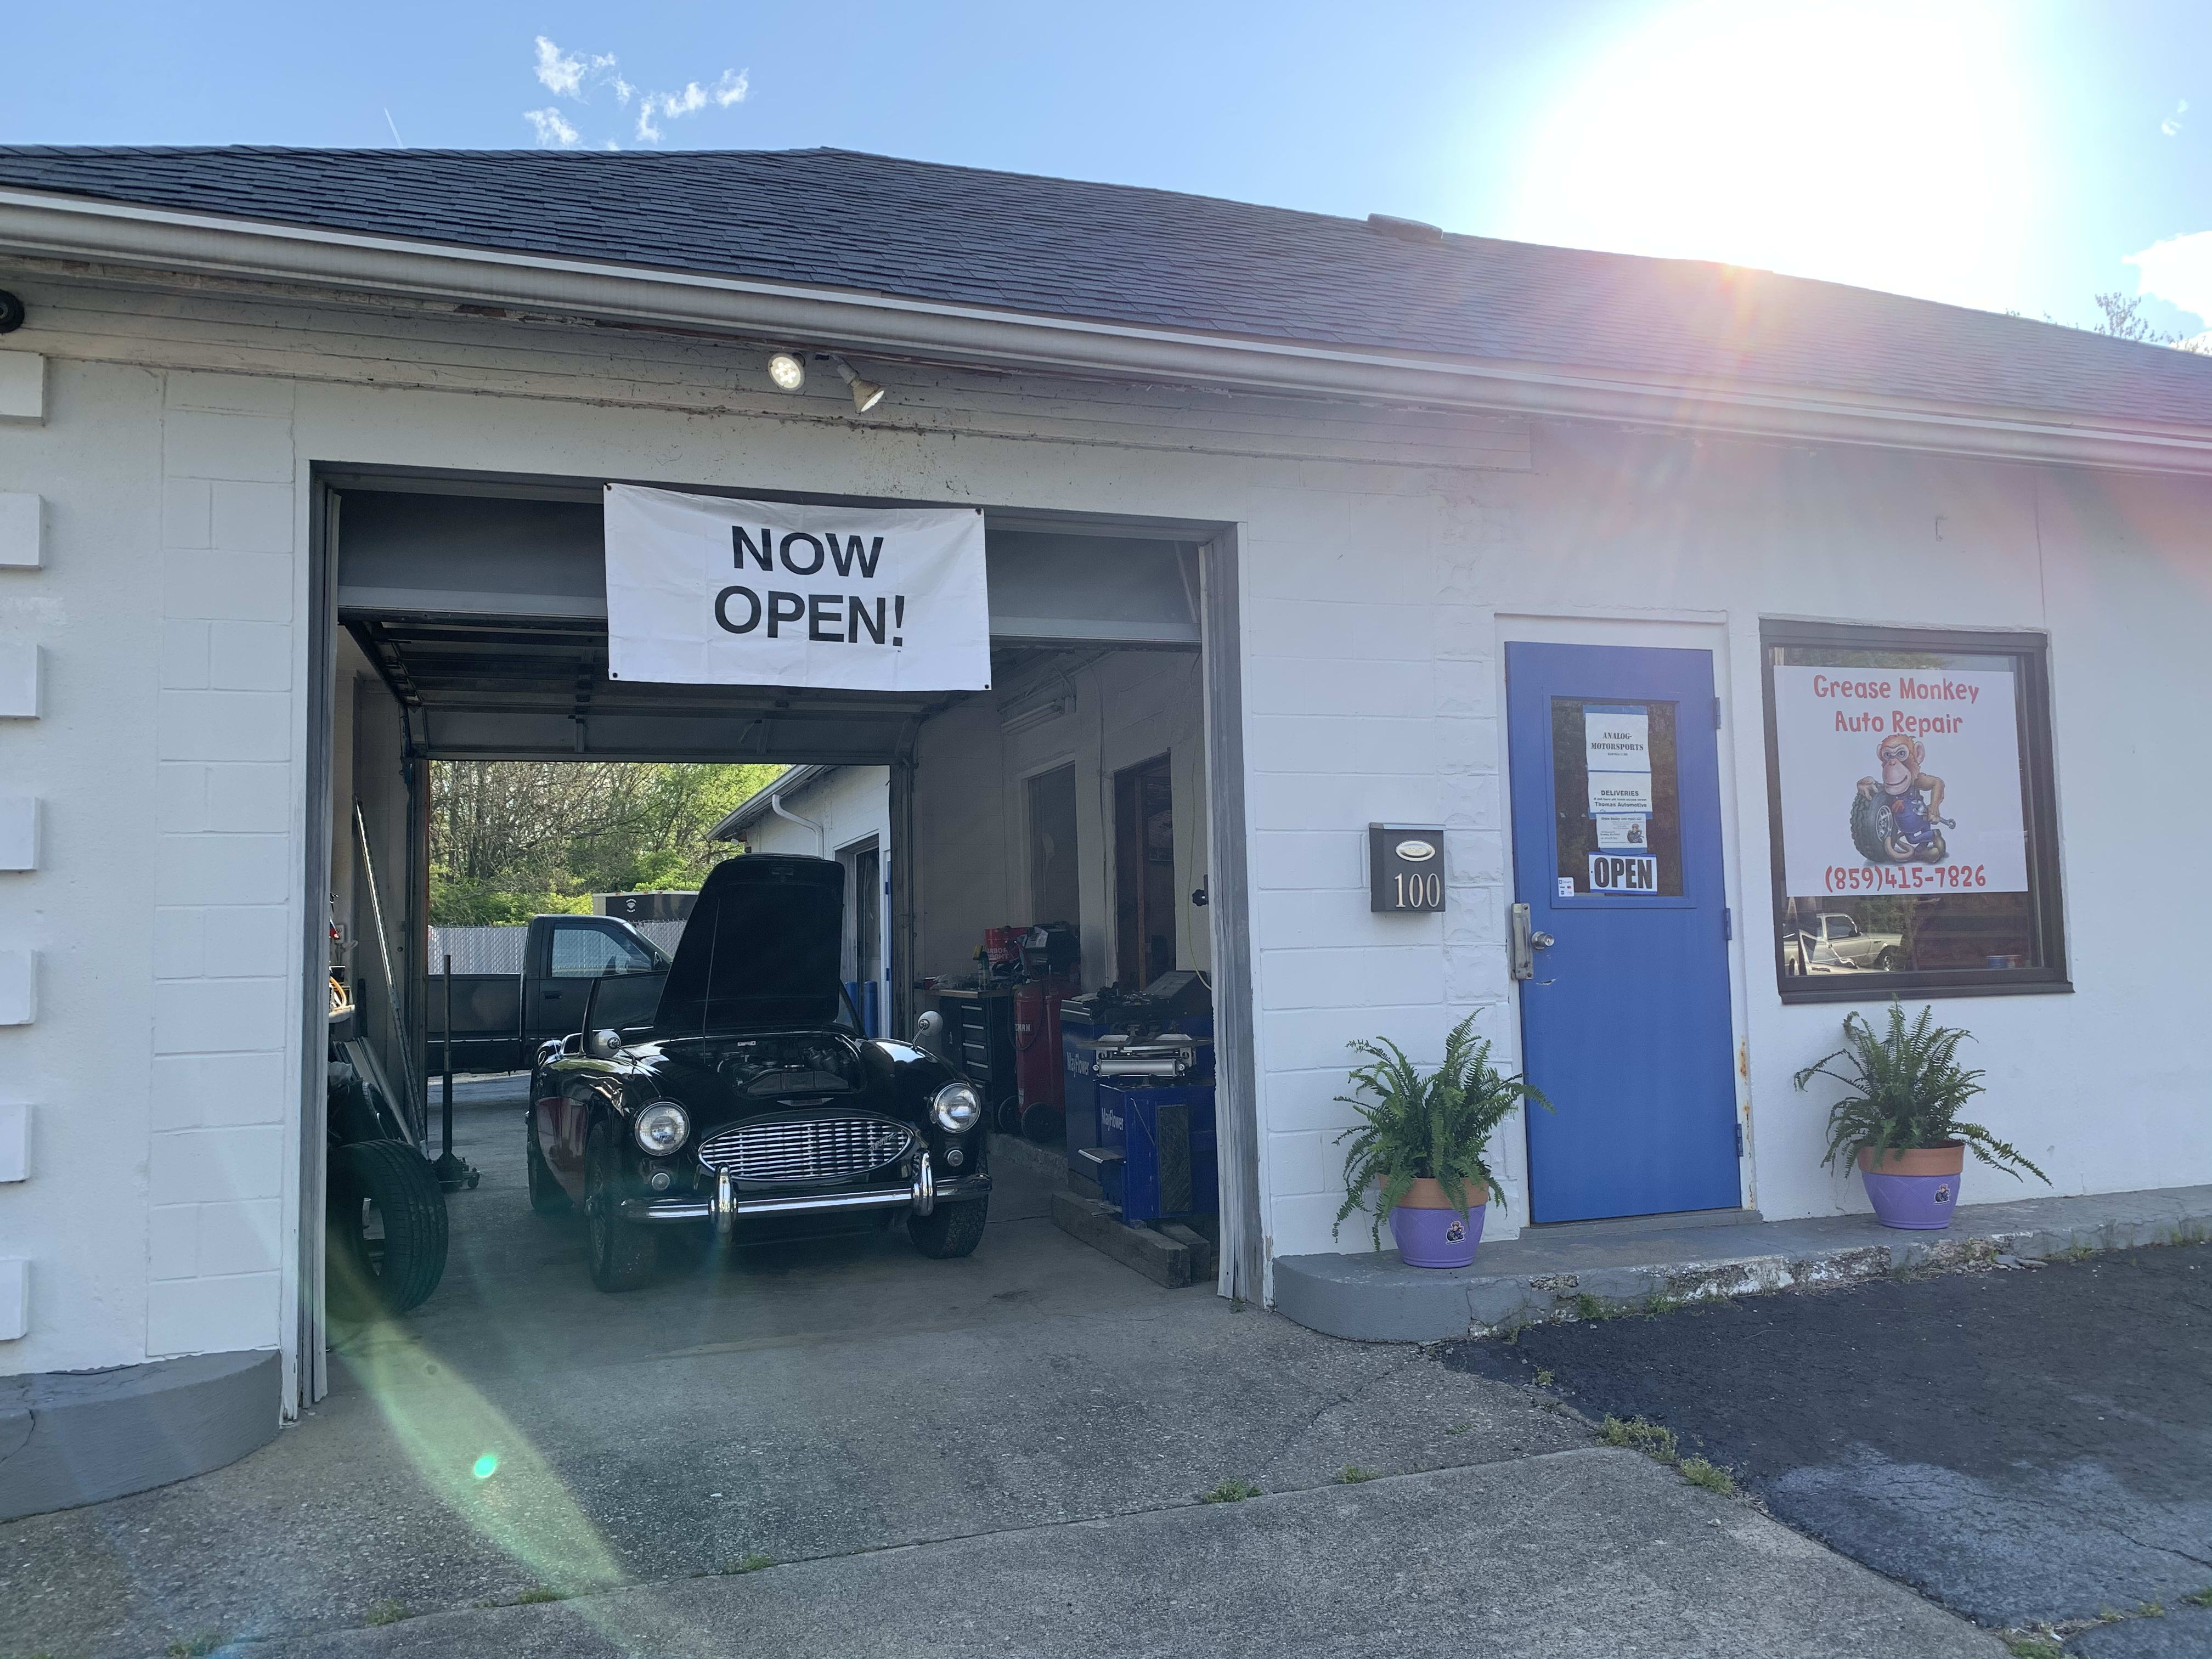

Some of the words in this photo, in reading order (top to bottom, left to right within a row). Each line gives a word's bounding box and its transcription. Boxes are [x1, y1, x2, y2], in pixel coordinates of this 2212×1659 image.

[732, 526, 884, 578] NOW
[714, 585, 905, 647] OPEN!
[1814, 675, 1891, 699] Grease
[1899, 678, 1980, 704] Monkey
[1835, 710, 1884, 732] Auto
[1893, 710, 1963, 737] Repair
[1591, 742, 1644, 751] MOTORSPORTS
[1594, 856, 1652, 889] OPEN
[1825, 865, 1987, 892] (859)415-7826
[1394, 873, 1440, 907] 100
[1067, 1051, 1090, 1077] MayFlower
[1101, 1107, 1124, 1132] MayFlower
